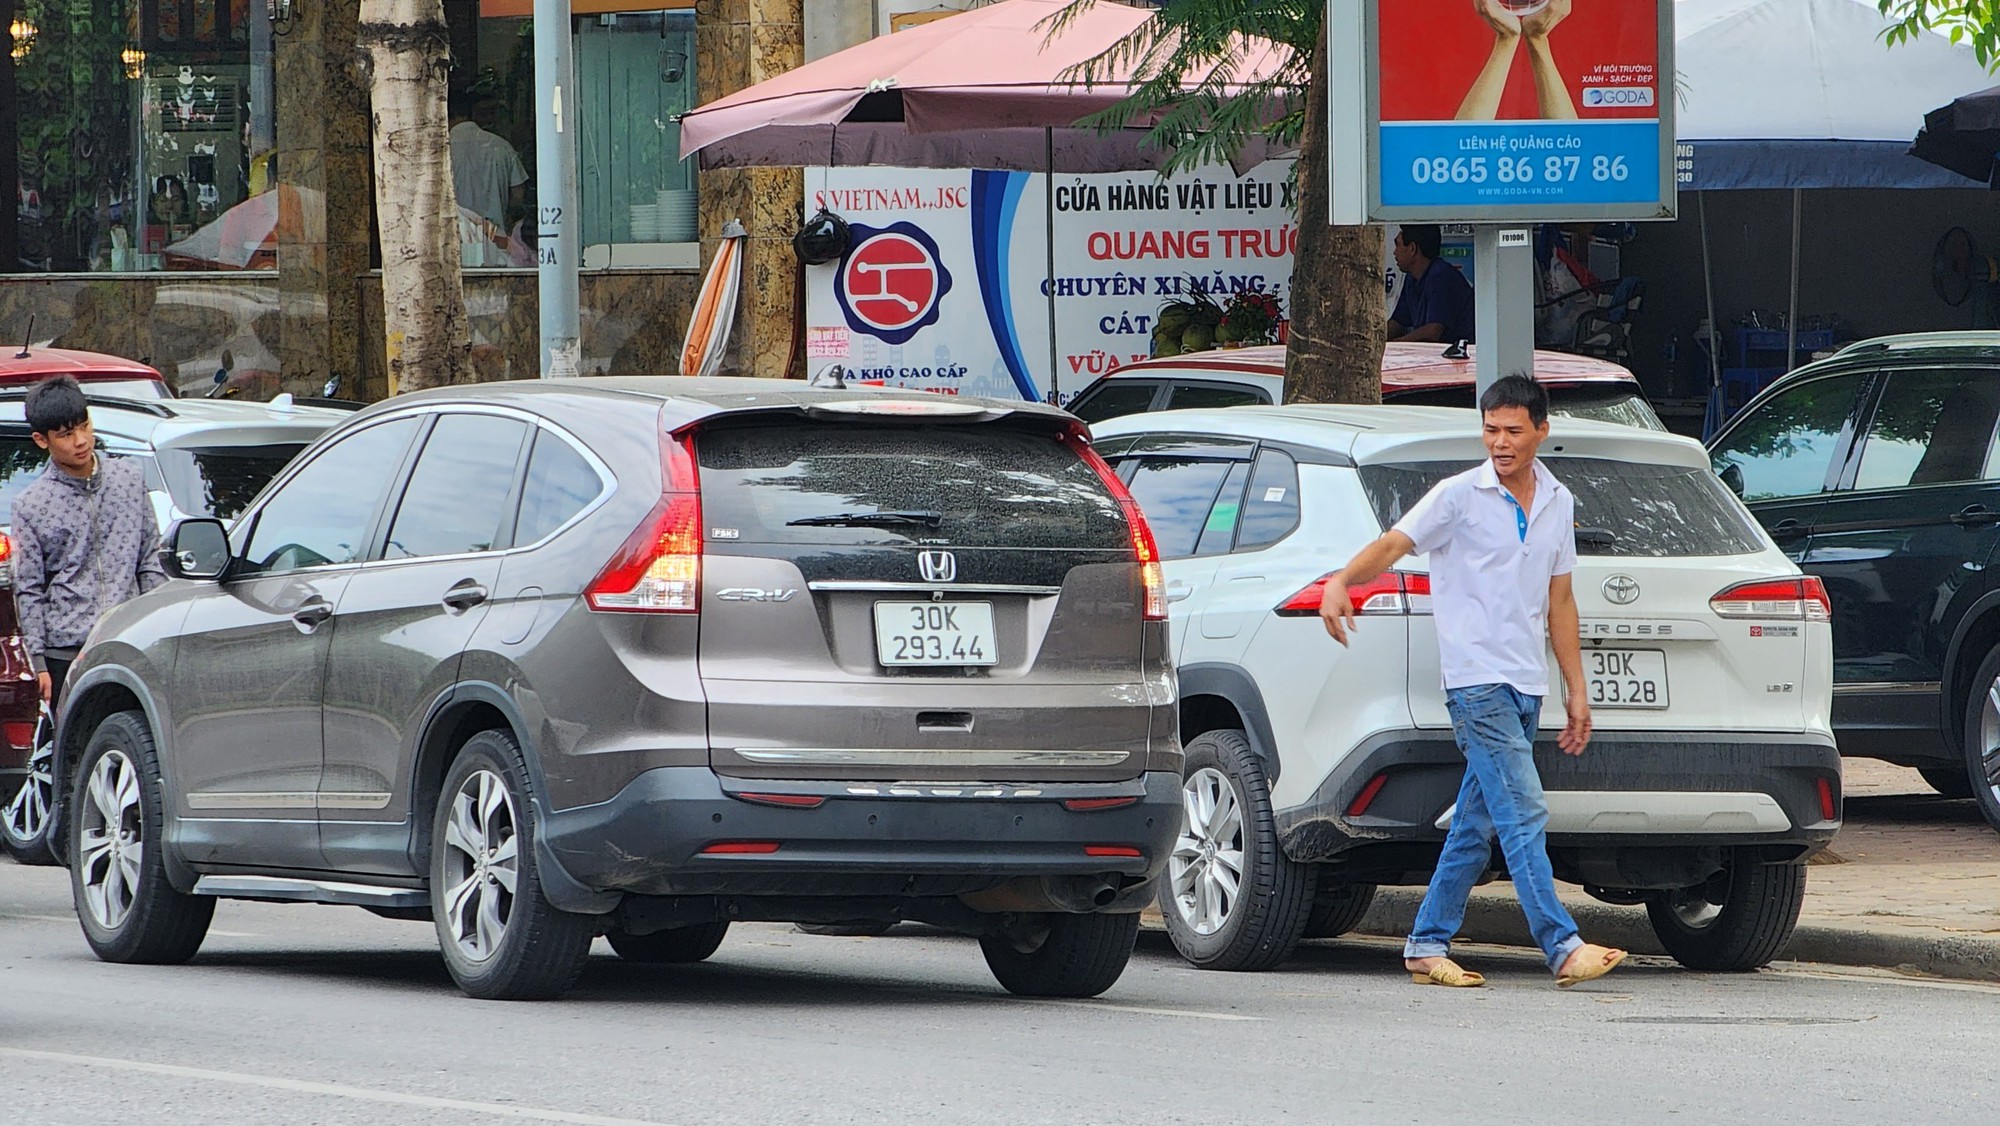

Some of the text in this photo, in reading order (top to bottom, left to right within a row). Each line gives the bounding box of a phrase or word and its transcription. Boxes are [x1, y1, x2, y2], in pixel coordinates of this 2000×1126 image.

[1582, 75, 1604, 83] XANH
[1610, 75, 1631, 84] SẠCH
[1603, 90, 1648, 103] GODA
[1459, 134, 1581, 152] LIÊN HỆ QUẢNG CÁO
[1412, 155, 1629, 184] 0865 86 87 86
[1055, 177, 1101, 212] CỬA
[1108, 179, 1170, 211] HÀNG
[1175, 178, 1217, 216] VẬT
[1224, 177, 1272, 215] LIỆU
[1477, 187, 1564, 196] WWW.GODA-VN.COM
[1087, 231, 1210, 260] QUANG
[1040, 272, 1146, 297] CHUYÊN
[1154, 276, 1182, 296] XI
[1189, 270, 1267, 297] MĂNG
[1100, 311, 1151, 335] CÁT
[861, 365, 894, 380] KHÔ
[899, 367, 932, 378] CAO
[936, 362, 968, 378] CẤP
[716, 588, 798, 602] CR-V
[910, 606, 961, 631] 30K
[892, 635, 984, 661] 293.44
[1591, 652, 1636, 676] 30K
[1591, 680, 1657, 703] 33.28
